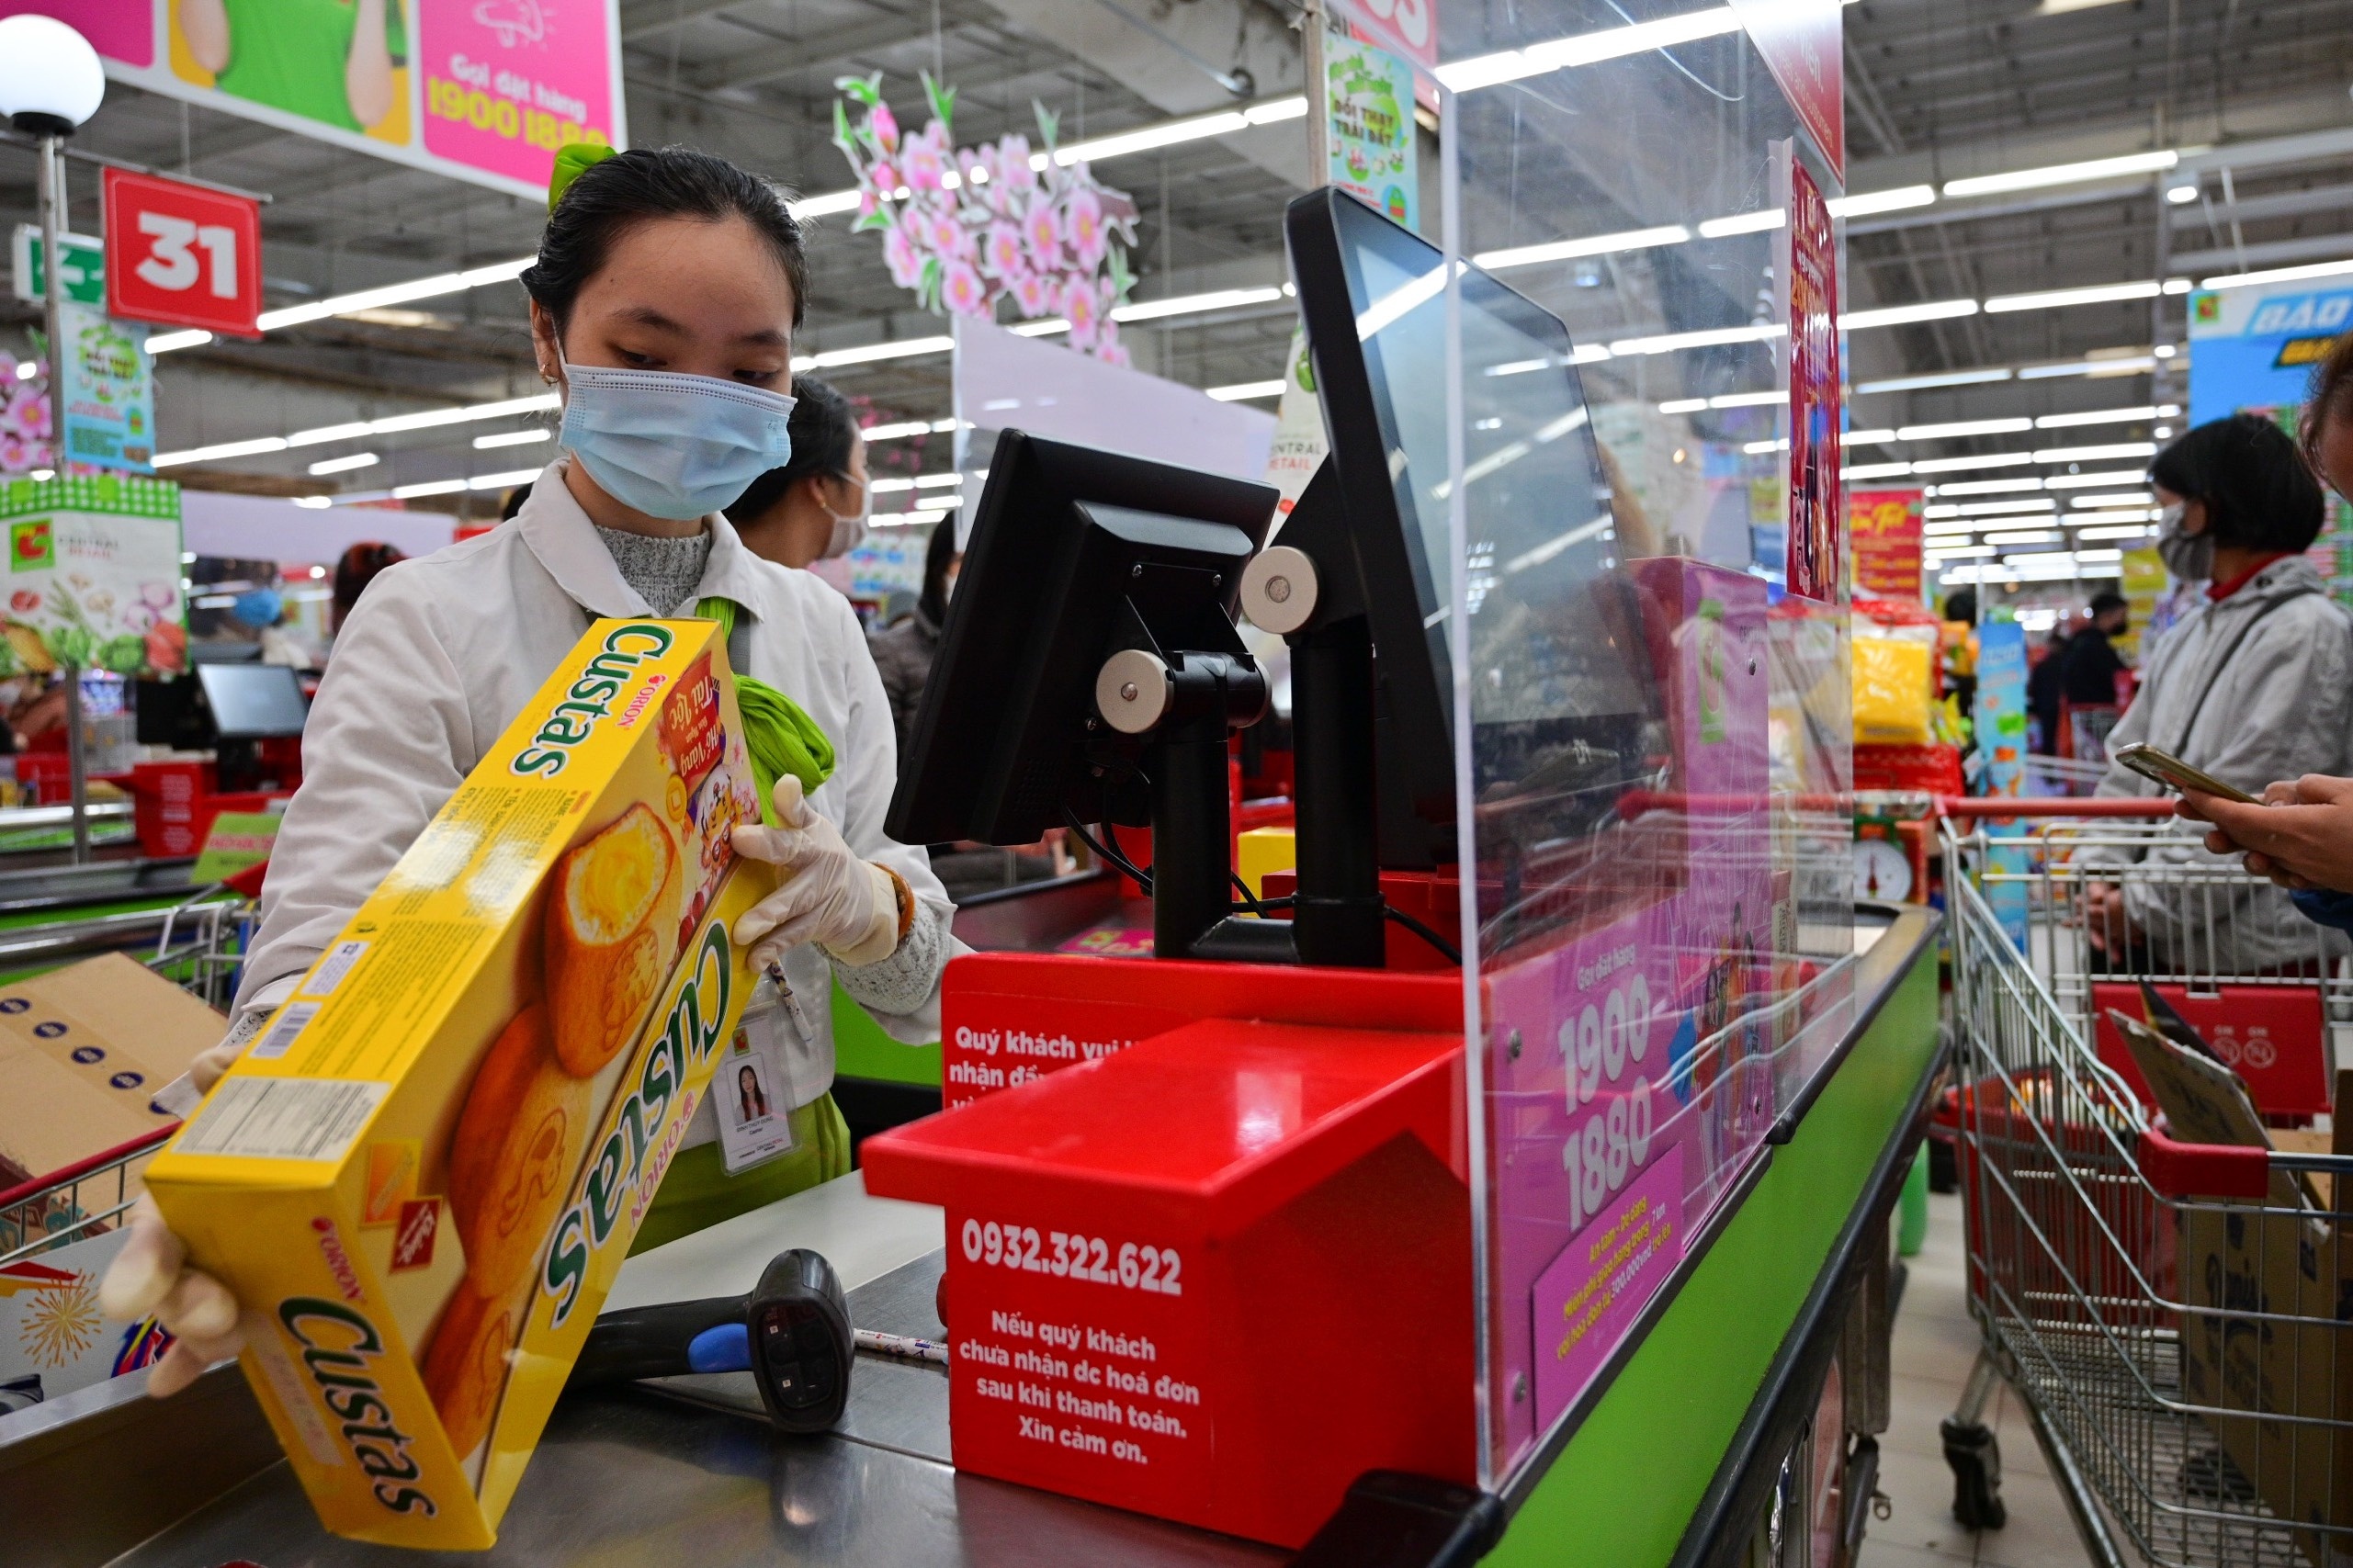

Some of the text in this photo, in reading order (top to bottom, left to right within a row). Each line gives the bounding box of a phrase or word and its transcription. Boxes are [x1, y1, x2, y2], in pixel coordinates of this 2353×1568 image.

[428, 76, 520, 140] 1900
[135, 210, 238, 301] 31
[1269, 456, 1312, 471] ETAIL
[509, 624, 674, 780] Custas
[617, 684, 657, 728] ORION
[949, 1060, 1045, 1090] nhận đầ
[956, 1026, 1001, 1055] Quý
[1006, 1030, 1076, 1059] khách
[1557, 973, 1650, 1117] 1900
[546, 919, 732, 1329] Custas
[1561, 1075, 1652, 1232] 1880
[630, 1118, 681, 1228] ORION
[962, 1218, 1183, 1296] 0932.322.622
[991, 1310, 1156, 1360] Nếu quý khách
[959, 1338, 1200, 1405] chưa nhận dc hoá đơn
[277, 1295, 438, 1517] Custas
[977, 1377, 1187, 1438] sau khi thanh toán.
[1018, 1415, 1148, 1464] Xin cảm ơn.
